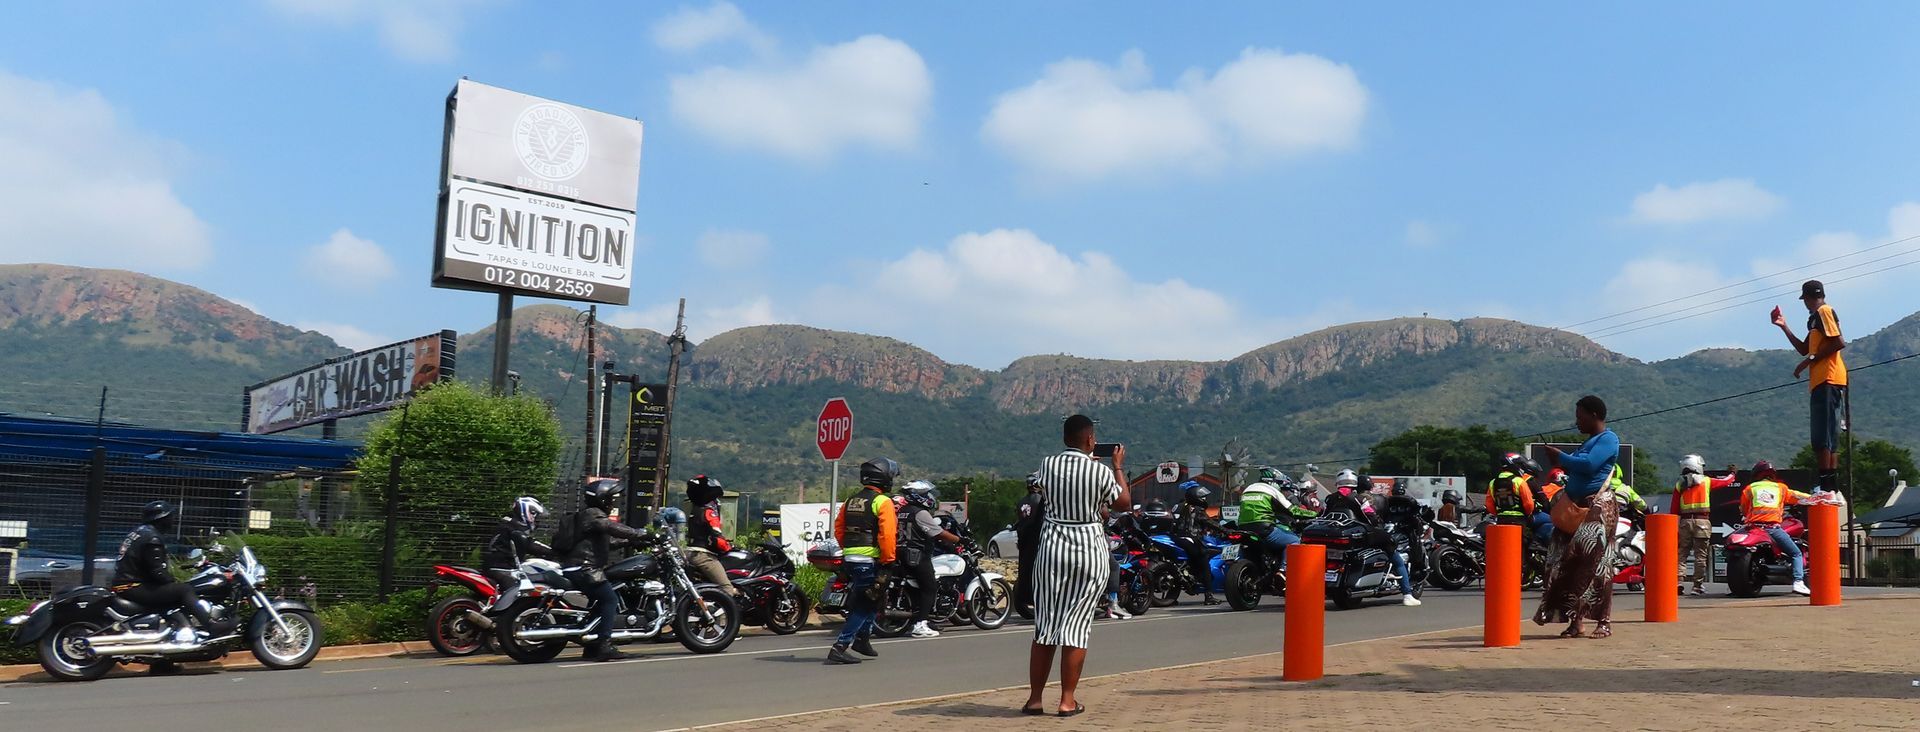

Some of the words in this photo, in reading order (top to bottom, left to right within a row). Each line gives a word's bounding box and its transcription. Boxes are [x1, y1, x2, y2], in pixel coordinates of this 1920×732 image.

[529, 108, 585, 148] ROADHOUSE
[525, 153, 557, 176] FIRED
[560, 161, 574, 175] UP
[516, 175, 533, 188] 012
[455, 200, 629, 268] IGNITION
[487, 253, 519, 266] TAPAS
[532, 261, 572, 275] LOUNGE
[576, 267, 596, 278] BAR
[484, 266, 516, 286] 012
[520, 272, 551, 291] 004
[555, 278, 595, 297] 2559
[293, 370, 328, 419] CAR
[336, 348, 406, 410] WASH
[820, 416, 849, 443] STOP
